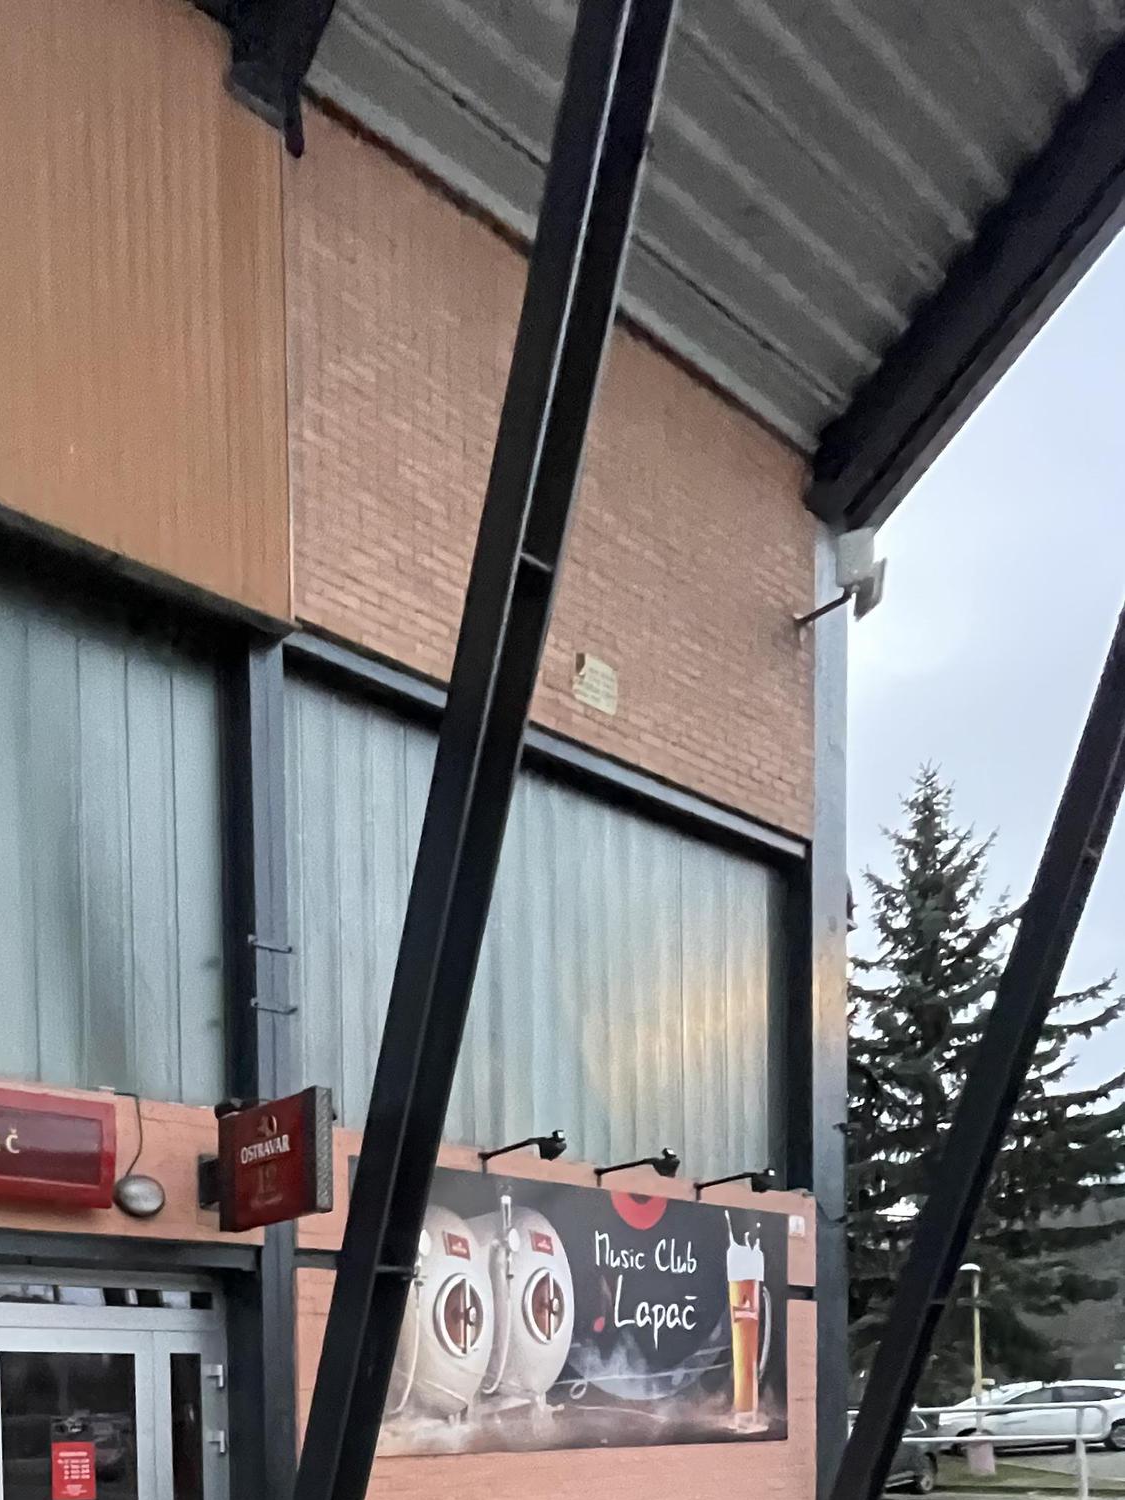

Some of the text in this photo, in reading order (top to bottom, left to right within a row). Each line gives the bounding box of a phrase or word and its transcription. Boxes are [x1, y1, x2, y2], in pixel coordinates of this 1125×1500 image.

[240, 1134, 291, 1164] OSTRAVAR
[594, 1230, 645, 1270] Music
[655, 1239, 697, 1274] Club
[614, 1276, 697, 1349] Lapač
